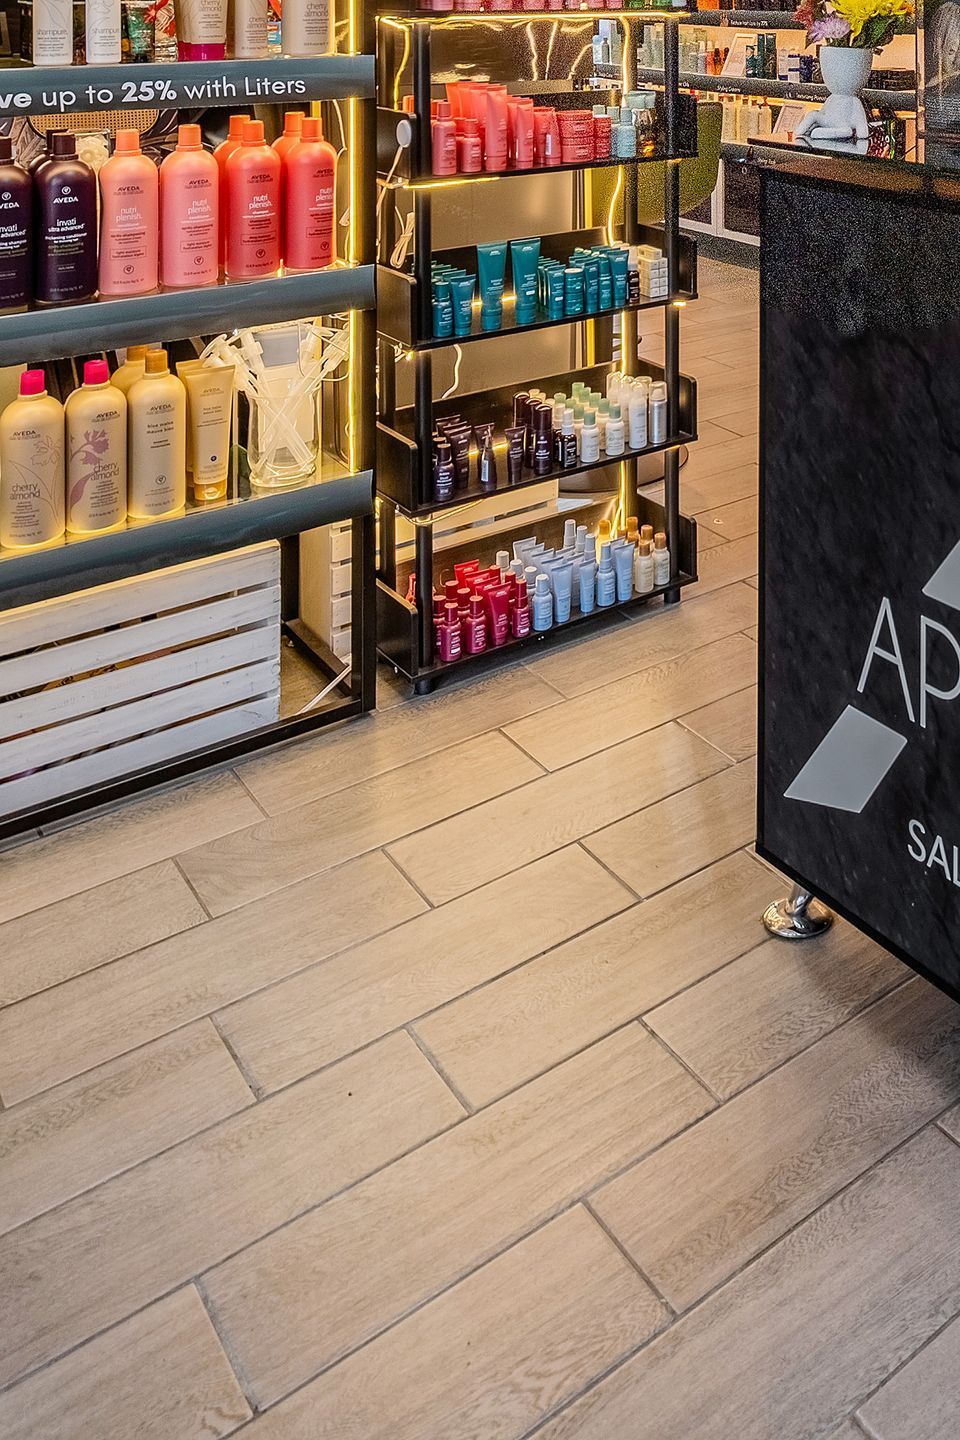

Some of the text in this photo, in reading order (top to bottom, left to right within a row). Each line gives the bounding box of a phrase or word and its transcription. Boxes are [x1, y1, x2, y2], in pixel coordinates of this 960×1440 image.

[42, 92, 76, 112] up
[86, 85, 114, 104] to
[121, 80, 177, 102] 25%
[184, 76, 236, 100] with
[244, 77, 306, 96] Liters
[188, 178, 209, 186] AVEDA
[53, 196, 79, 205] AVEDA
[253, 193, 268, 202] nutri
[192, 198, 208, 207] nutri
[120, 206, 137, 214] nutri
[56, 217, 77, 227] invati
[150, 403, 172, 411] AVEDA
[96, 410, 118, 419] AVEDA
[13, 429, 37, 437] AVEDA
[93, 462, 118, 473] cherry
[11, 483, 38, 493] cherry
[9, 490, 40, 500] almond
